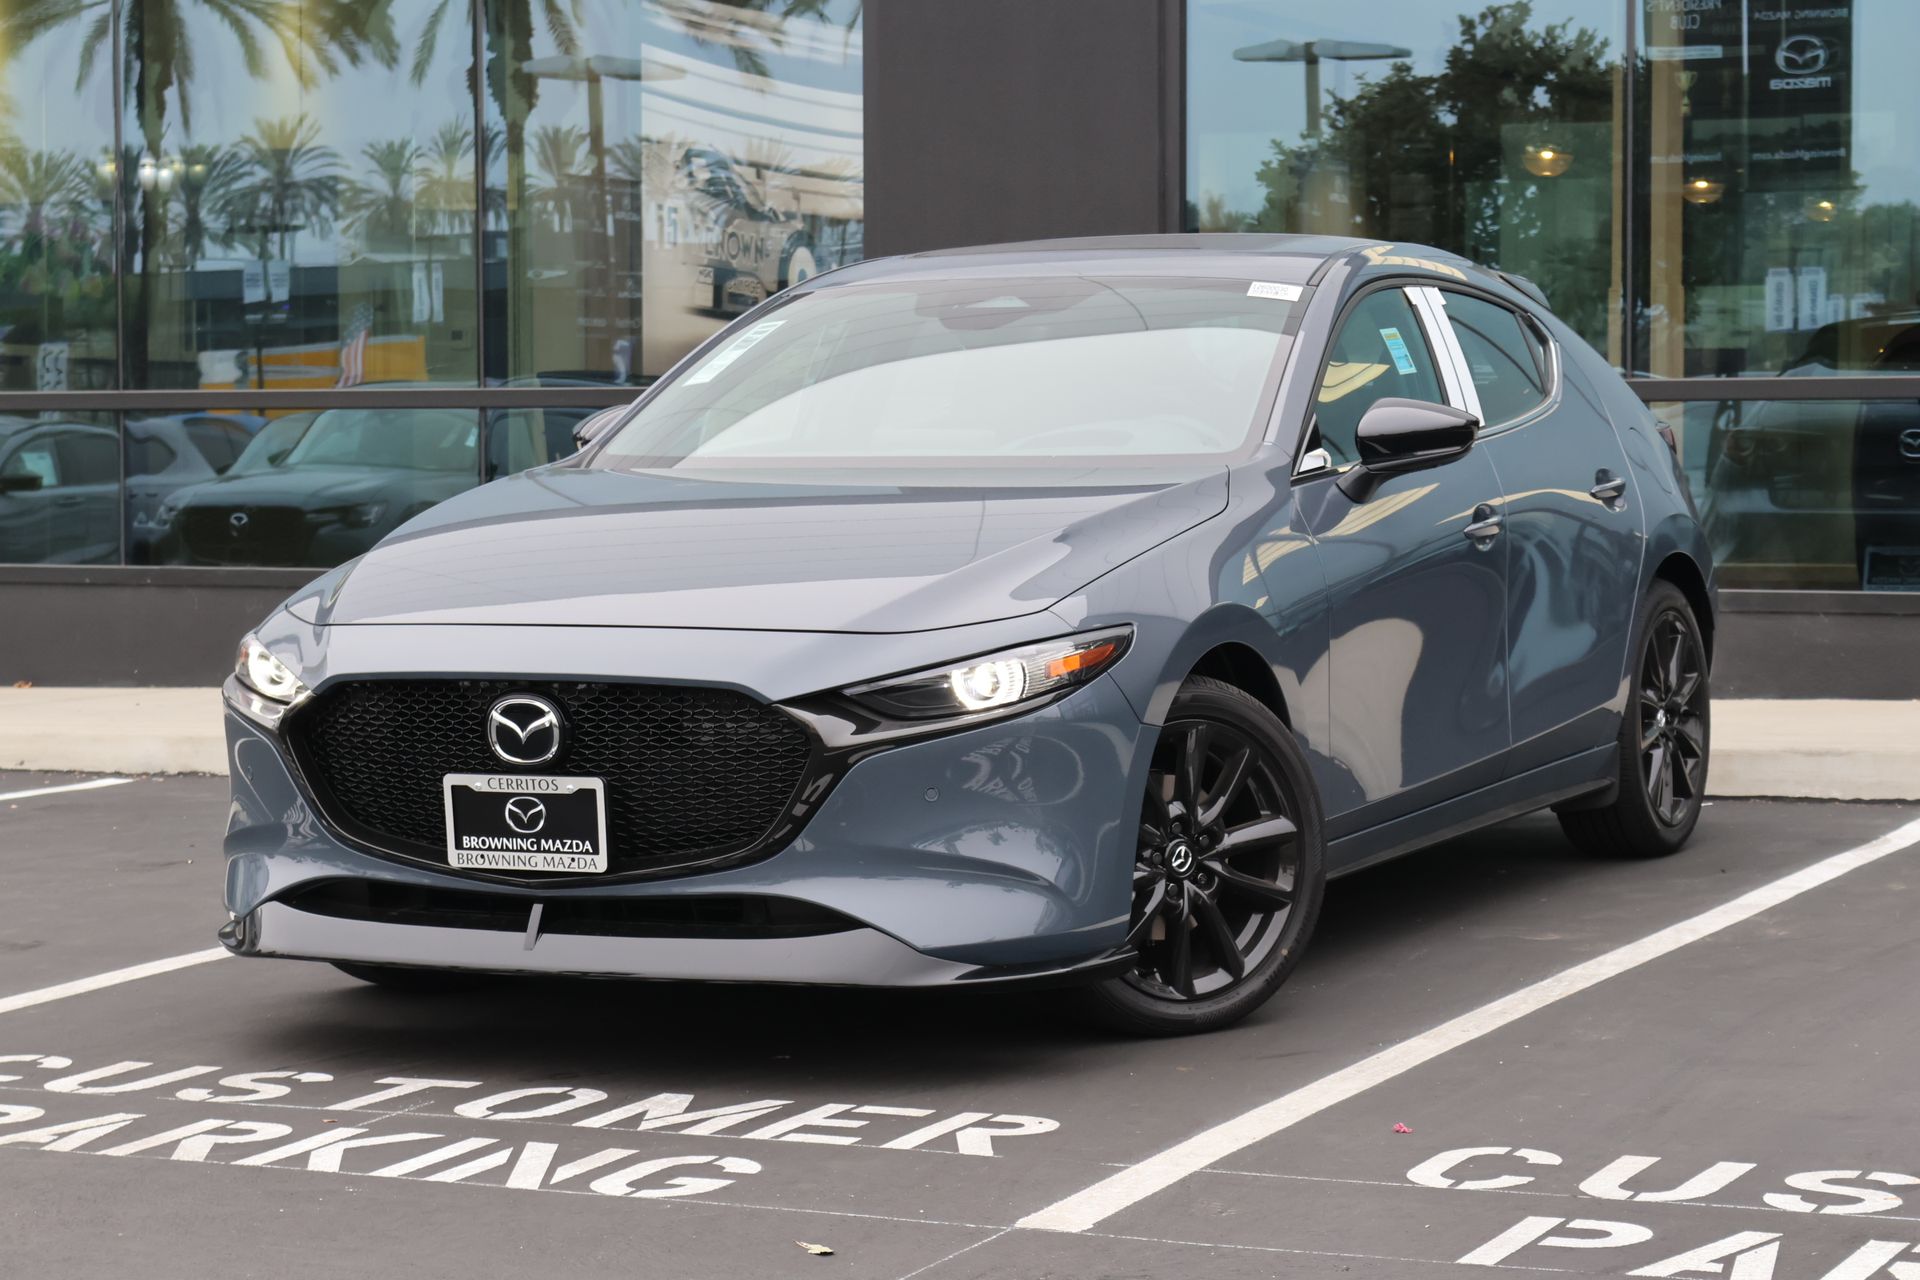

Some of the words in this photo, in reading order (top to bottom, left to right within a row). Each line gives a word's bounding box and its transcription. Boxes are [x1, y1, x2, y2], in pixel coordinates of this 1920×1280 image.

[487, 777, 559, 792] CERRITOS
[462, 835, 538, 851] BROWNING
[540, 839, 593, 853] MAZDA
[457, 852, 538, 868] BROWNING
[542, 856, 598, 870] MAZDA
